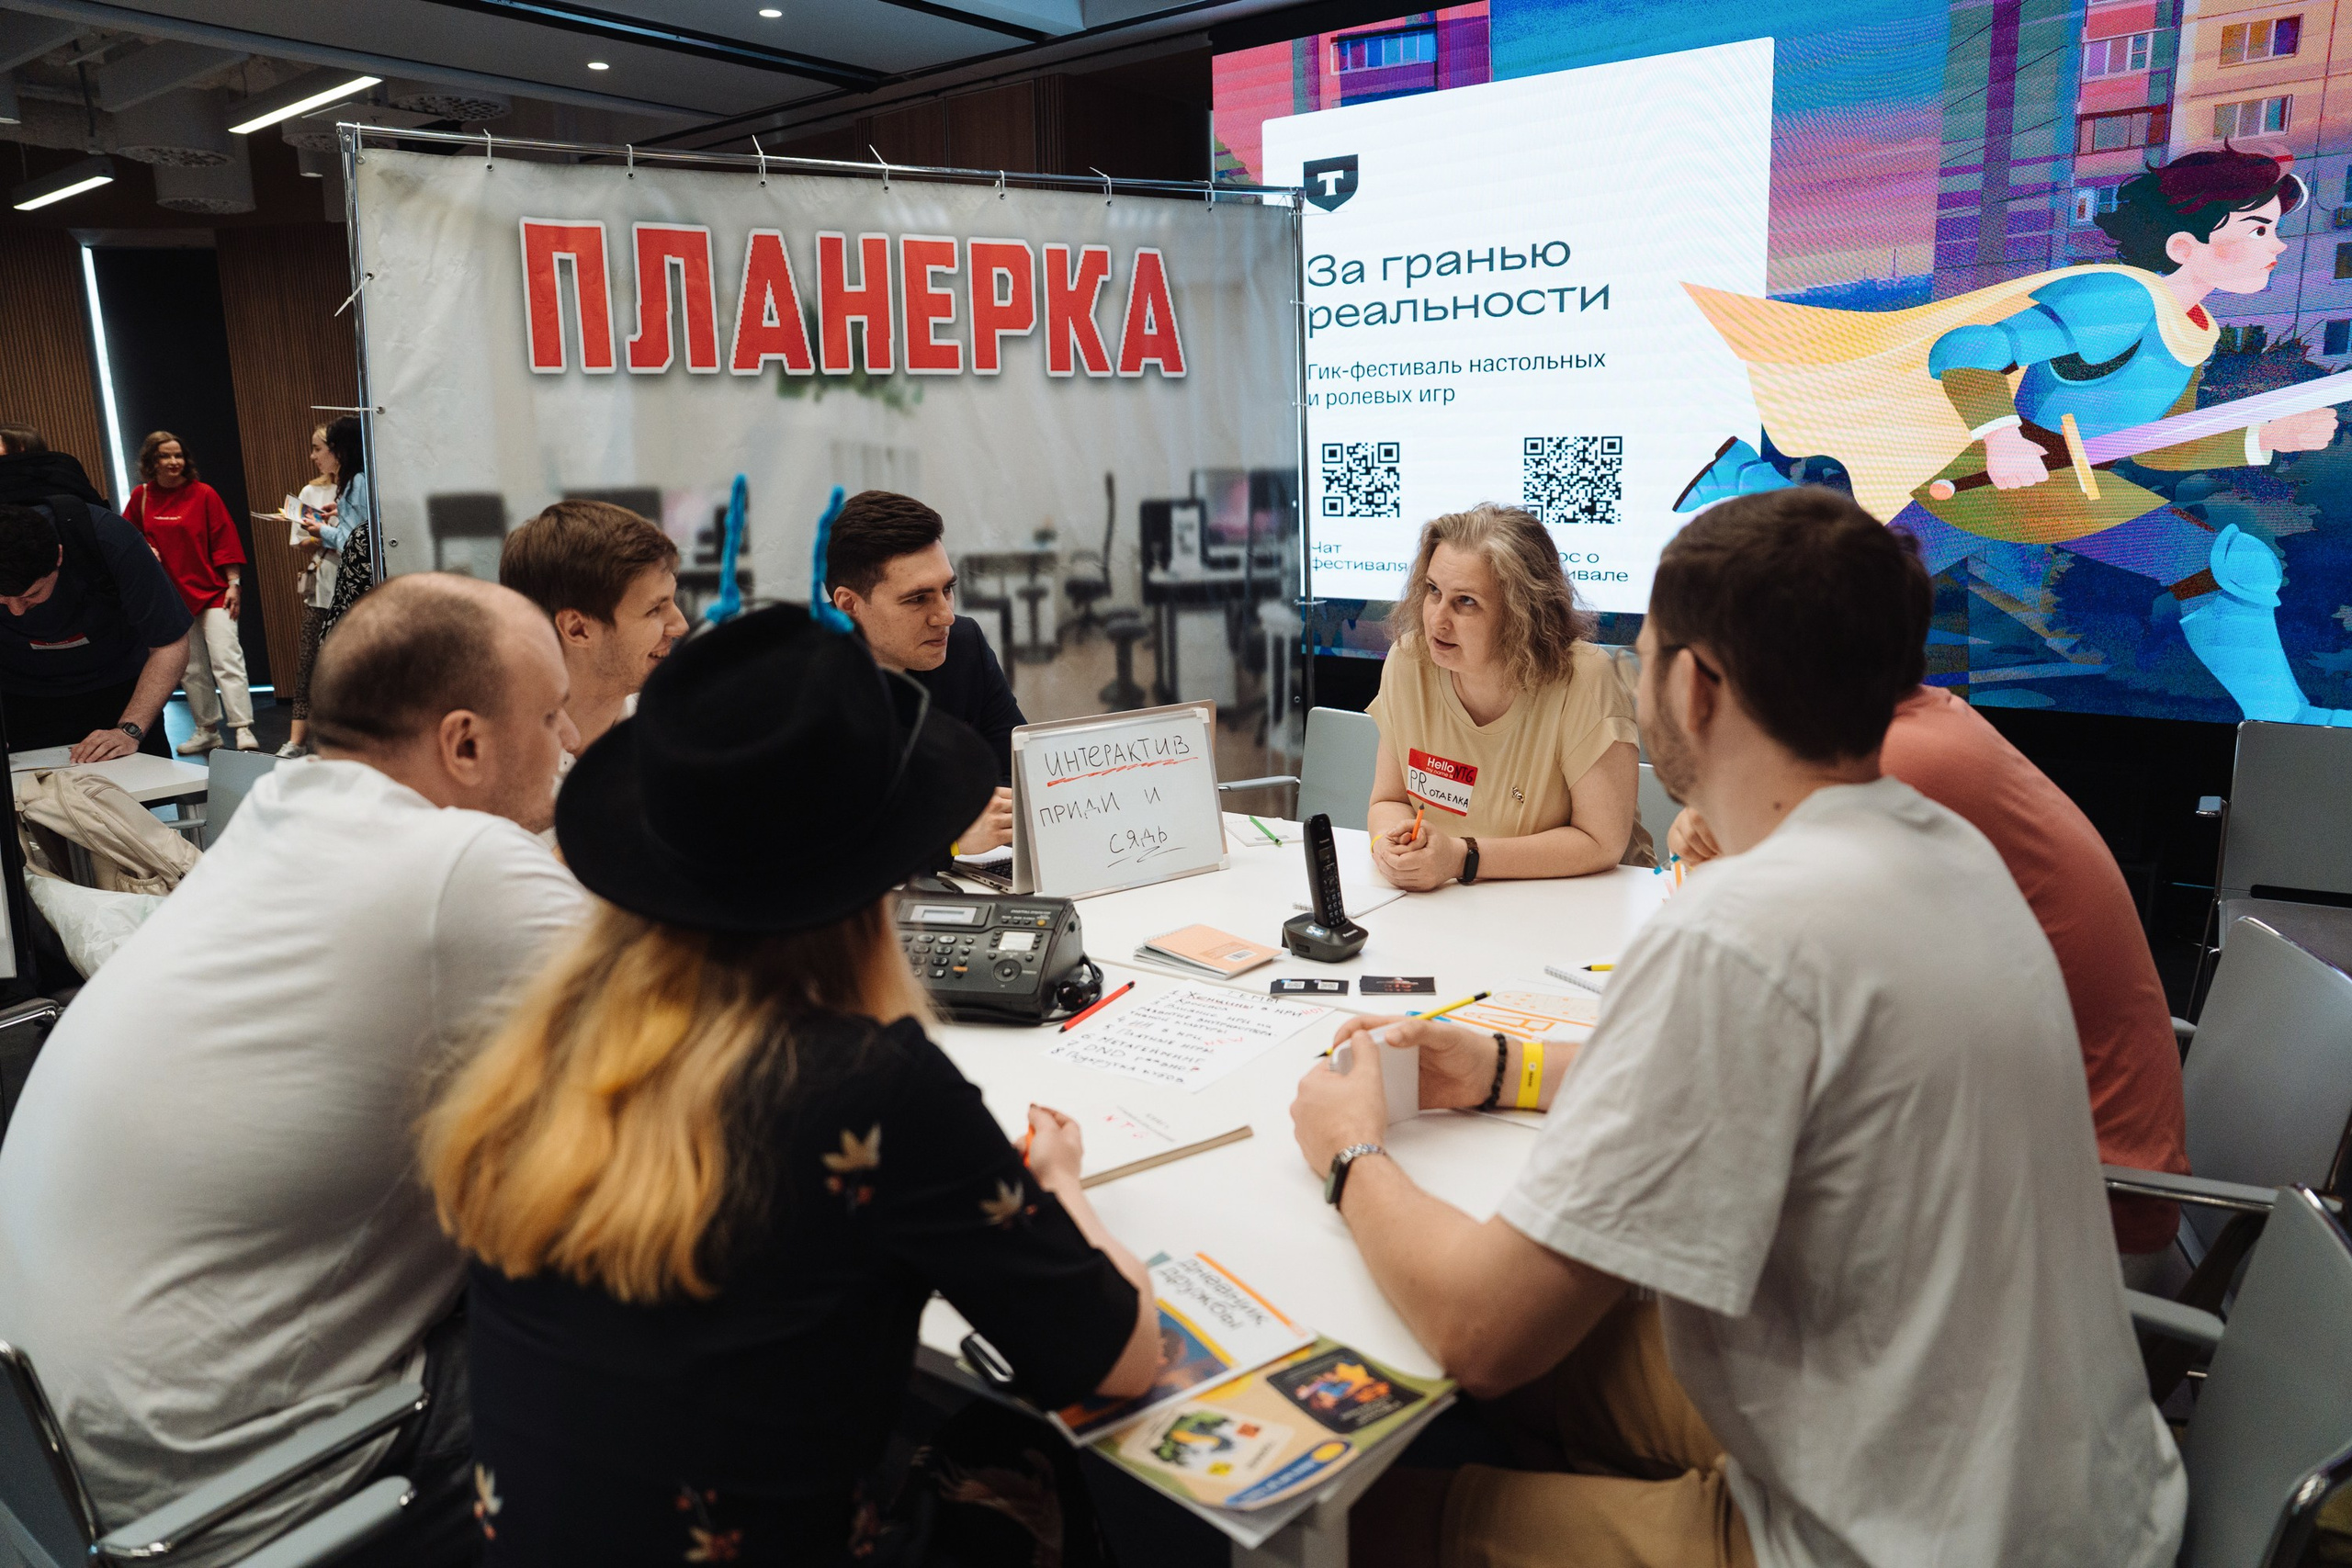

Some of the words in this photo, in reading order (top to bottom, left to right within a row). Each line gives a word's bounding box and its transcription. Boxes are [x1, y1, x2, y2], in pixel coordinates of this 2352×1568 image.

[1307, 254, 1365, 287] За
[1382, 241, 1571, 288] гранью
[519, 216, 1187, 378] ПЛАНЕРКА
[1307, 284, 1610, 338] реальности
[1307, 359, 1462, 381] Гик-фестиваль
[1470, 353, 1606, 372] настольных
[1308, 392, 1318, 406] и
[1326, 389, 1413, 409] ролевых
[1419, 386, 1455, 405] игр
[1311, 541, 1341, 554] Чат
[1311, 557, 1408, 571] фестиваля
[1045, 736, 1191, 777] ИНТЕРАКТИВ
[1427, 757, 1454, 773] Hello
[1039, 792, 1120, 827] ПРИДИ
[1144, 787, 1160, 805] И
[1109, 826, 1168, 853] СЯДЬ
